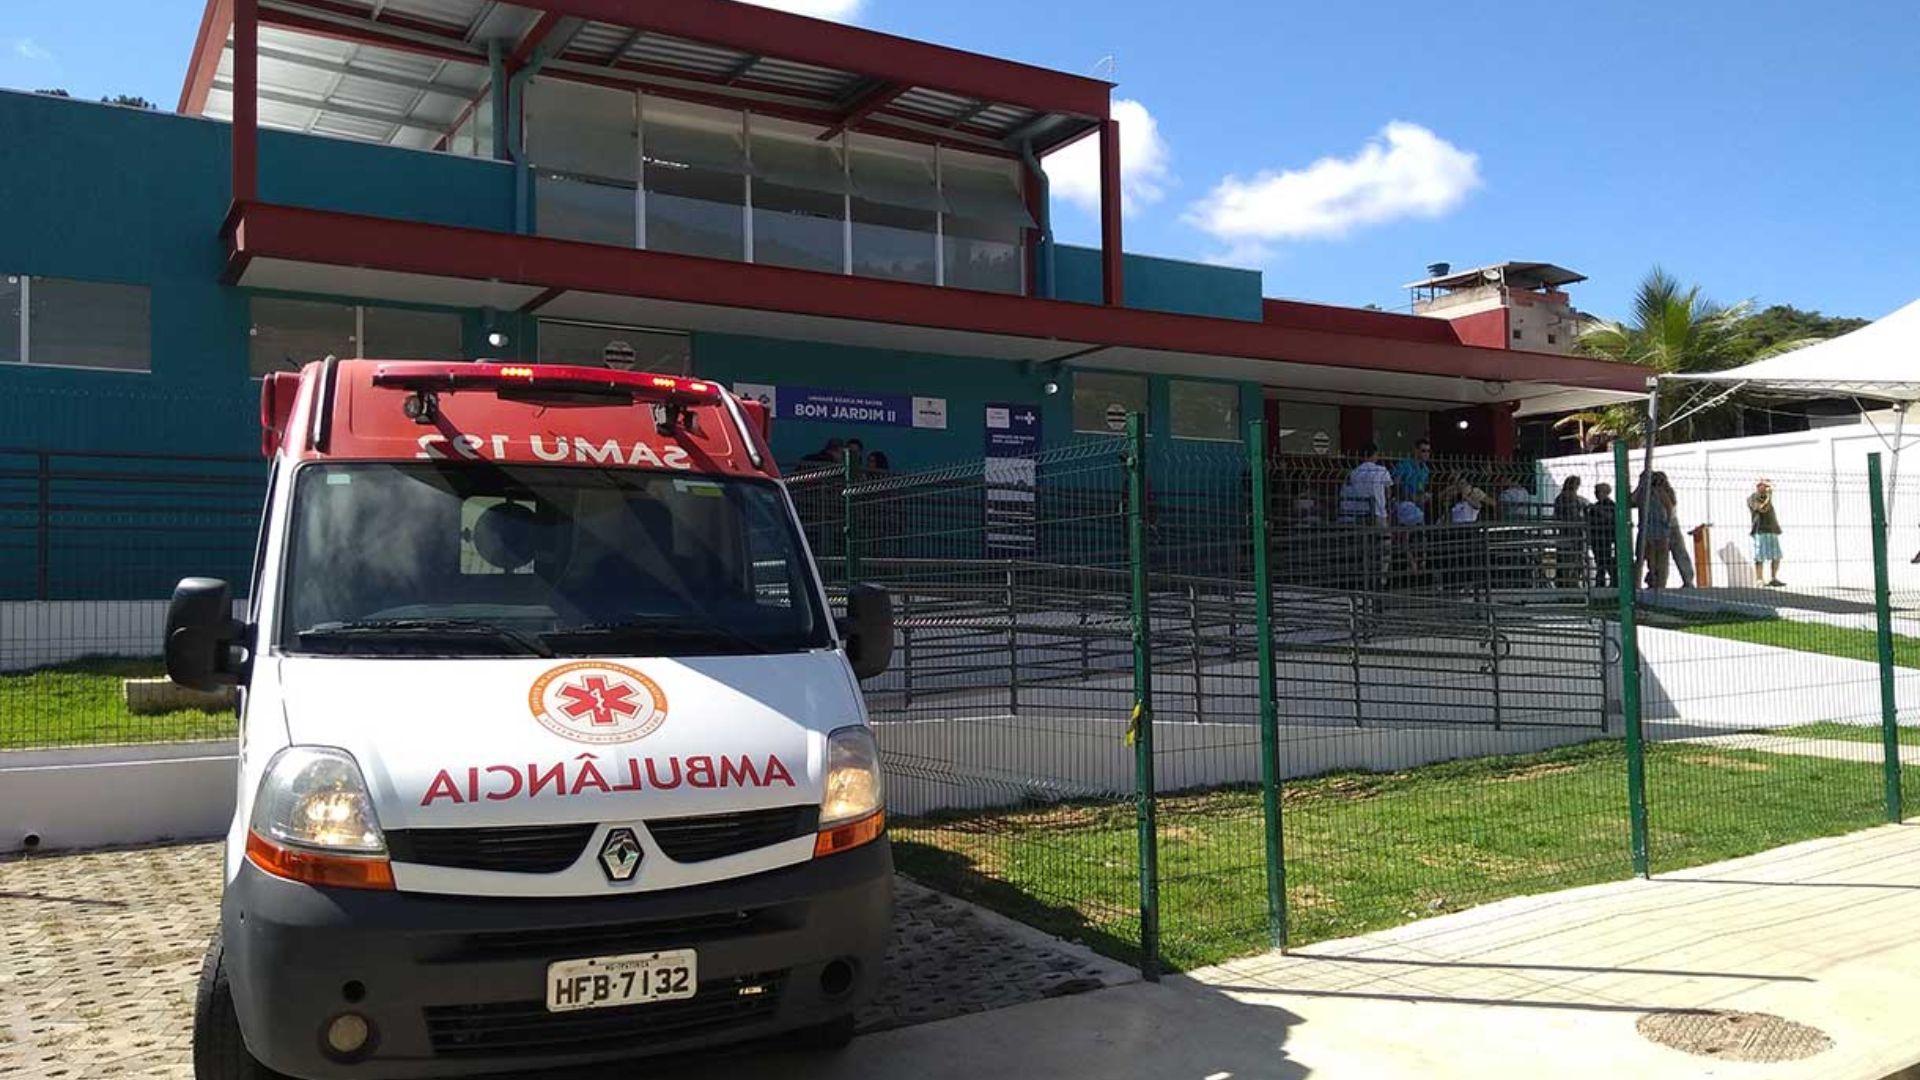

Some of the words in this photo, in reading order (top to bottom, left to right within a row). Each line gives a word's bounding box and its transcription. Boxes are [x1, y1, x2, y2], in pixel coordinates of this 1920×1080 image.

[794, 403, 828, 418] BOM
[830, 405, 884, 422] JARDIM
[887, 410, 896, 422] II
